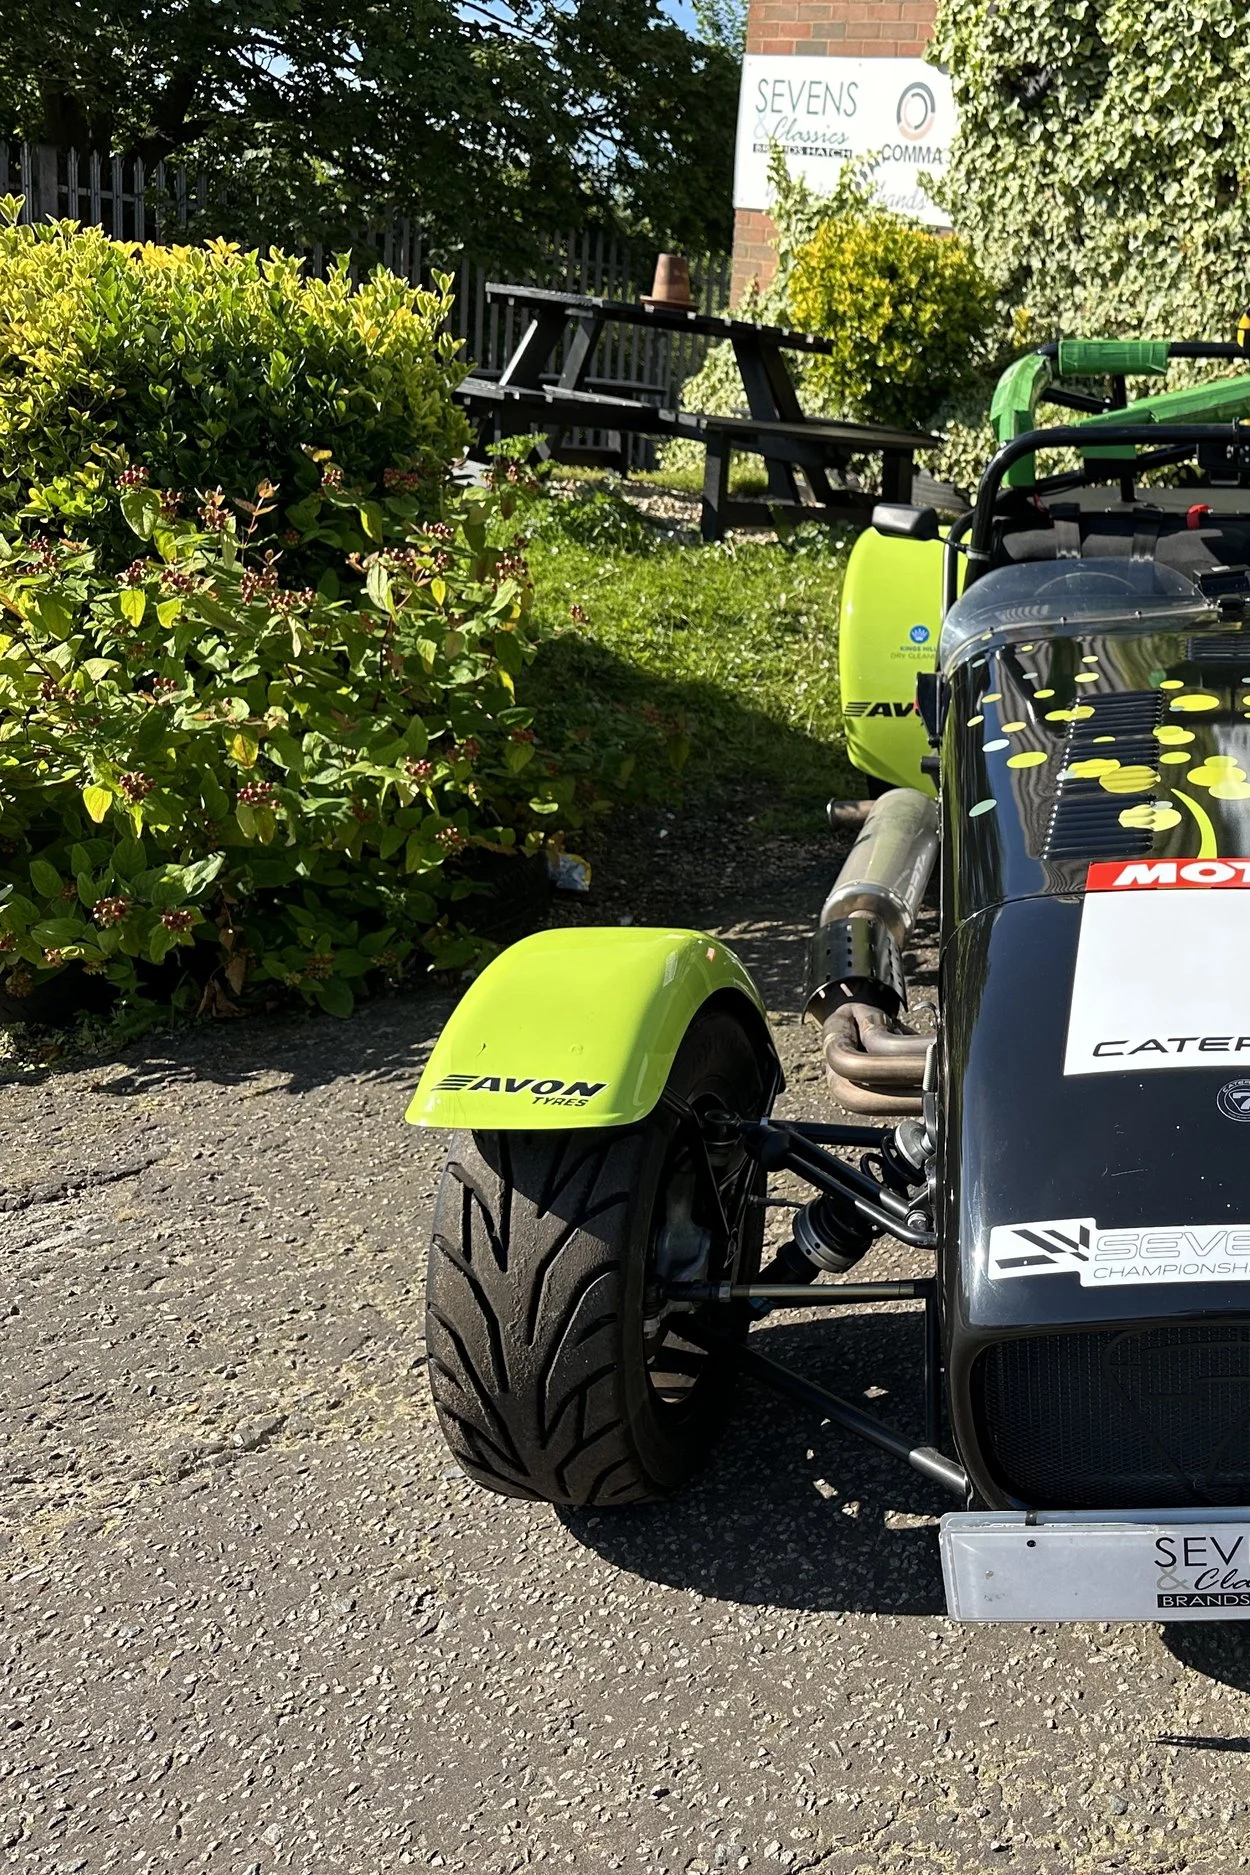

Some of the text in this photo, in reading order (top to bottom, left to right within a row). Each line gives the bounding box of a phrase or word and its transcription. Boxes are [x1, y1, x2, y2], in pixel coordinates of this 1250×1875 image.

[755, 78, 859, 117] SEVENS
[768, 116, 849, 144] Classics
[881, 144, 942, 164] COMMA
[467, 1076, 608, 1097] AVON
[532, 1097, 589, 1107] TYRES
[1162, 1593, 1250, 1607] BRANDS
